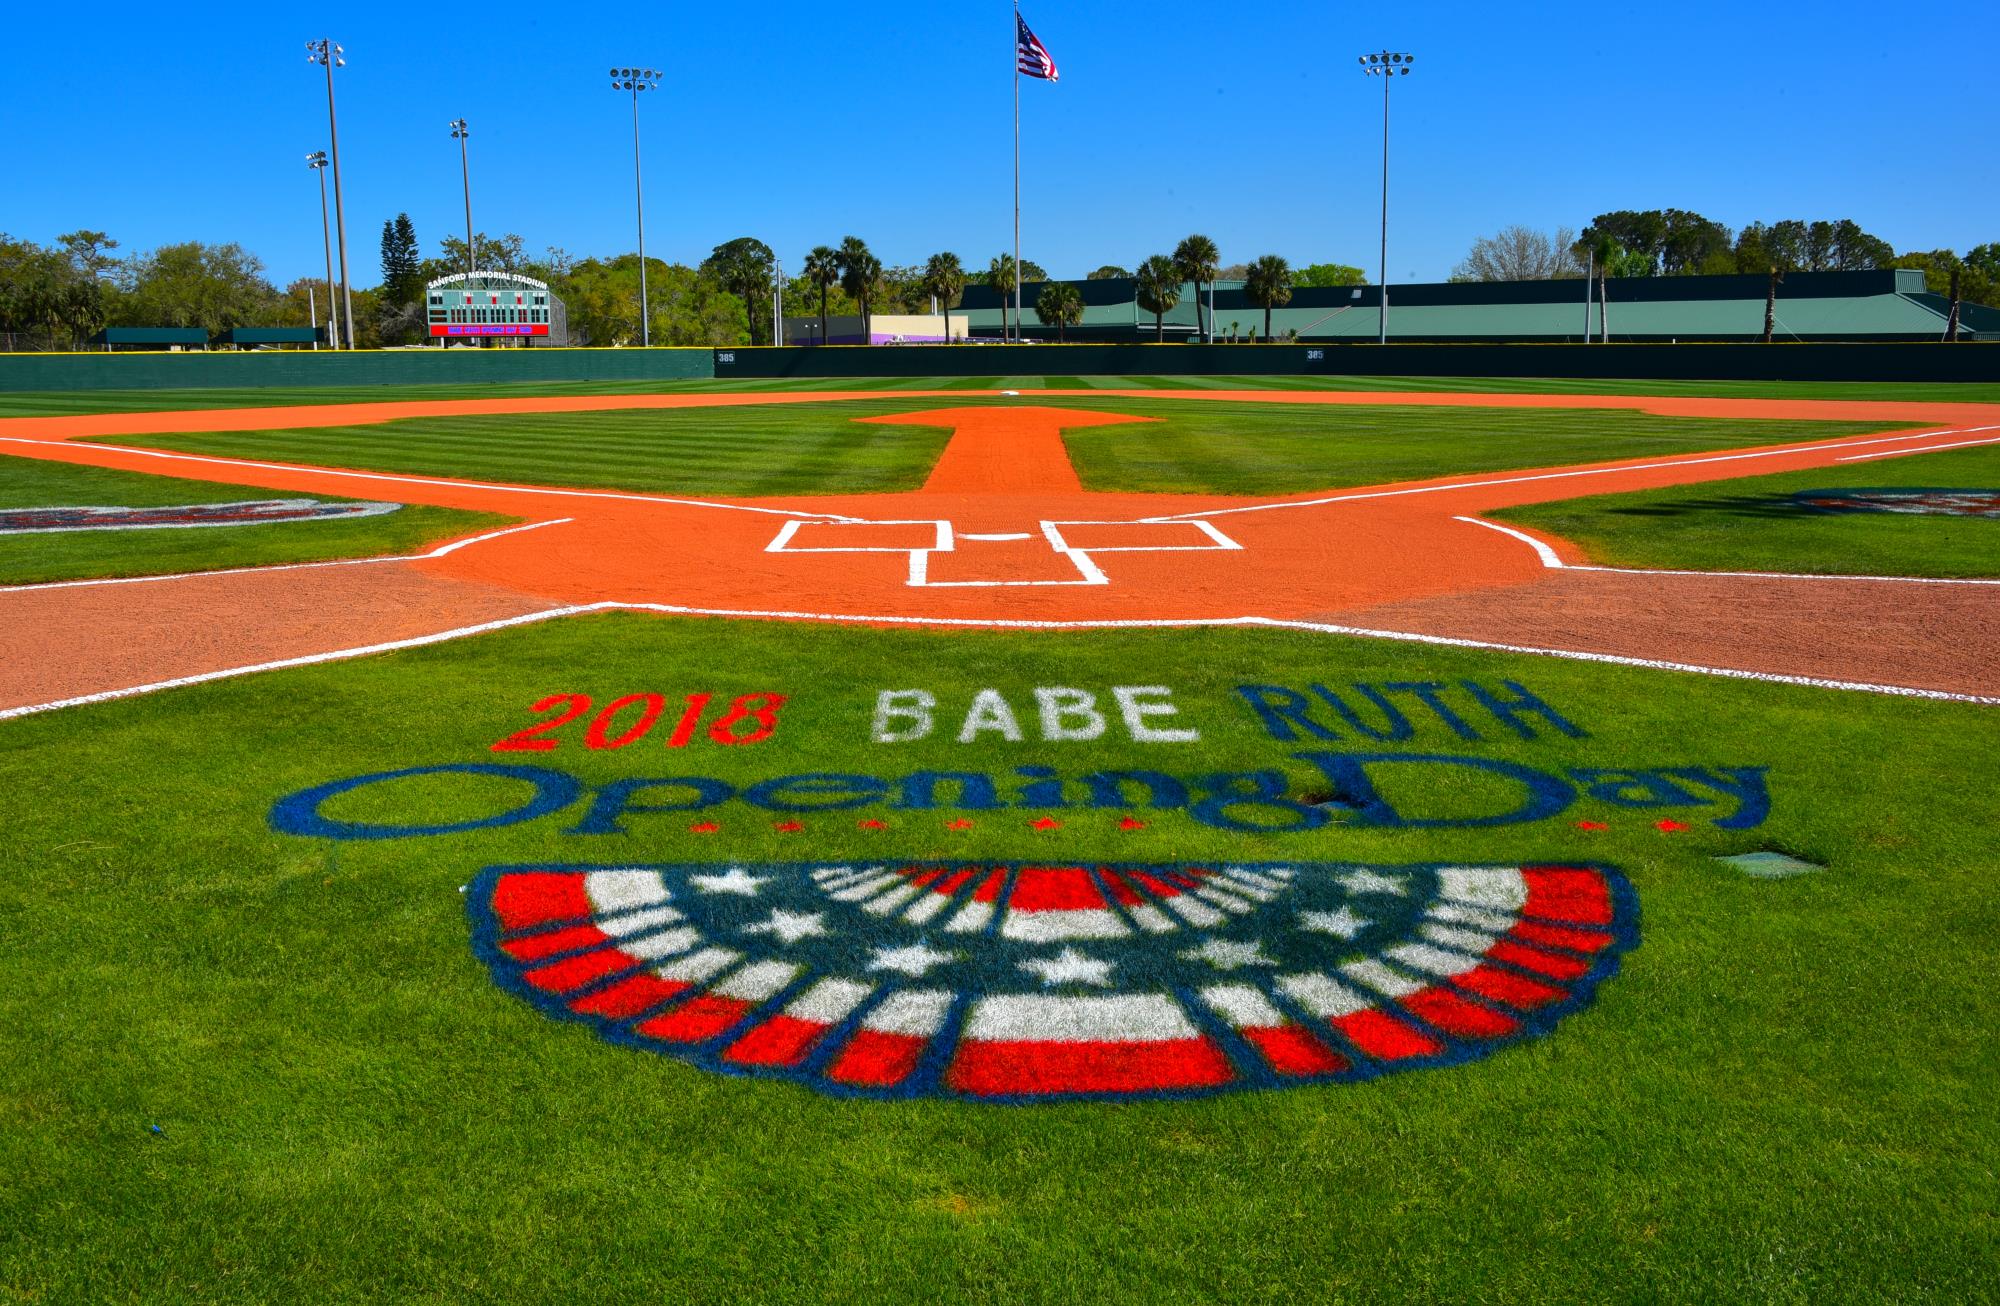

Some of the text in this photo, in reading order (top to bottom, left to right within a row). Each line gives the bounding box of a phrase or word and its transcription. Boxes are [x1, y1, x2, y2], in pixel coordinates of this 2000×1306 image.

[428, 271, 547, 290] SANFORD MEMORIAL STADIUM
[719, 353, 734, 362] 385
[1308, 350, 1324, 359] 385
[491, 680, 1590, 752] 2018 BABE RUTH
[267, 751, 1770, 840] Opening Day
